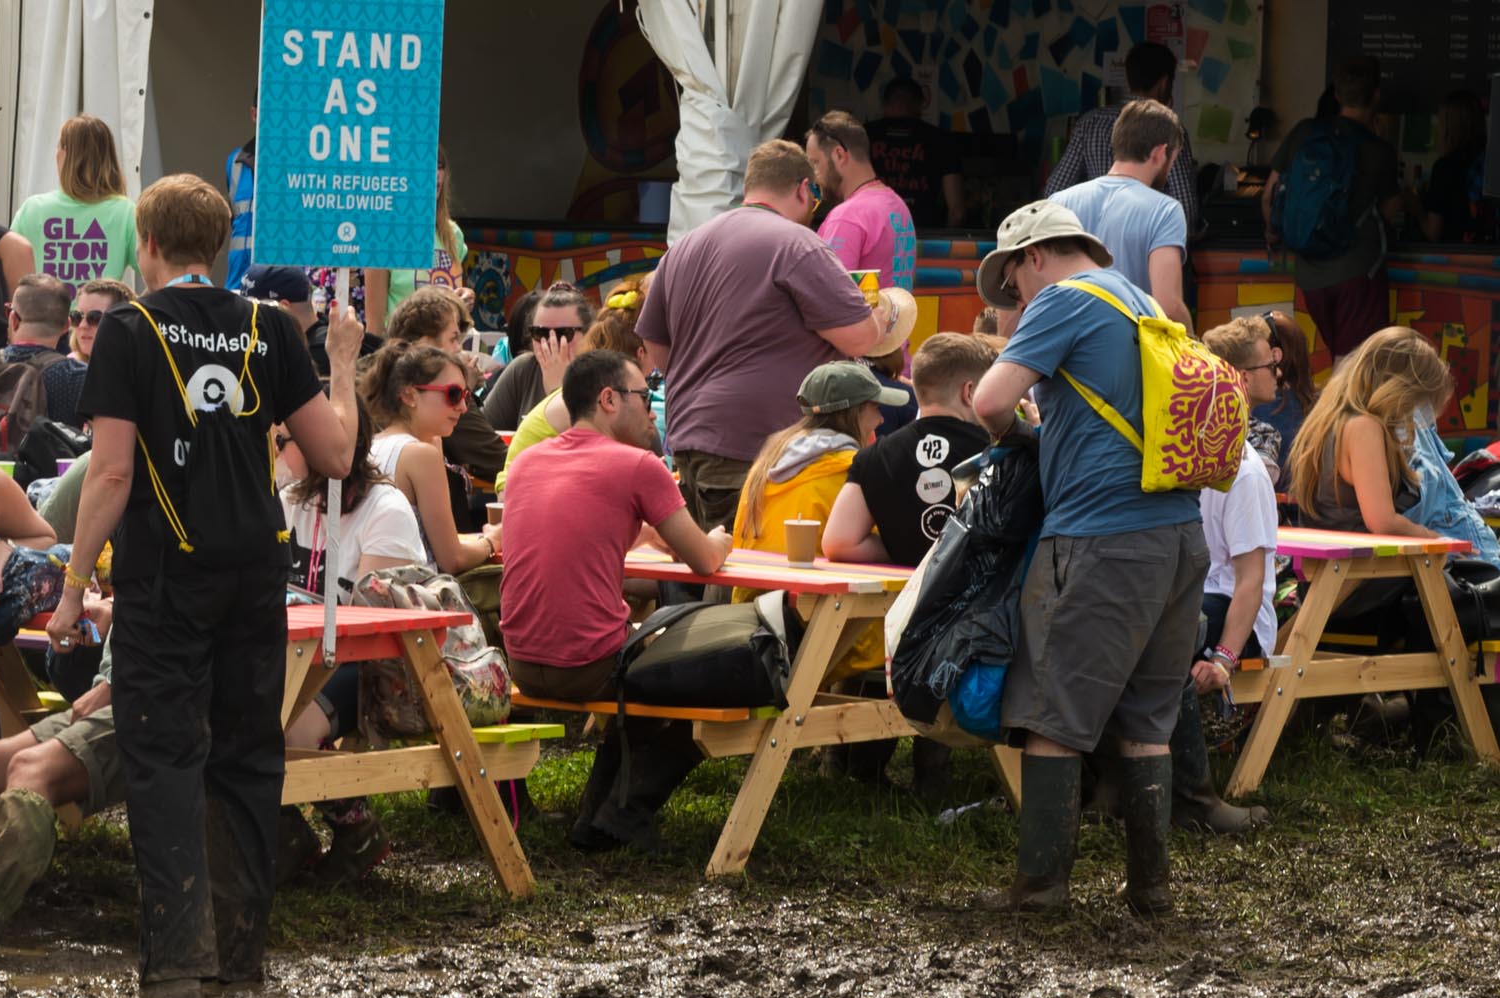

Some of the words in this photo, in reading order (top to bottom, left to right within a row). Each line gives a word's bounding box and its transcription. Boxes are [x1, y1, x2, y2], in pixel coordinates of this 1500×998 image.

[282, 29, 422, 70] STAND
[323, 78, 378, 116] AS
[309, 124, 391, 163] ONE
[287, 173, 327, 190] WITH
[332, 174, 408, 192] REFUGEES
[301, 193, 394, 211] WORLDWIDE
[43, 242, 108, 261] STON
[332, 244, 360, 254] OXFAM
[43, 263, 107, 280] BURY
[923, 440, 942, 461] 42
